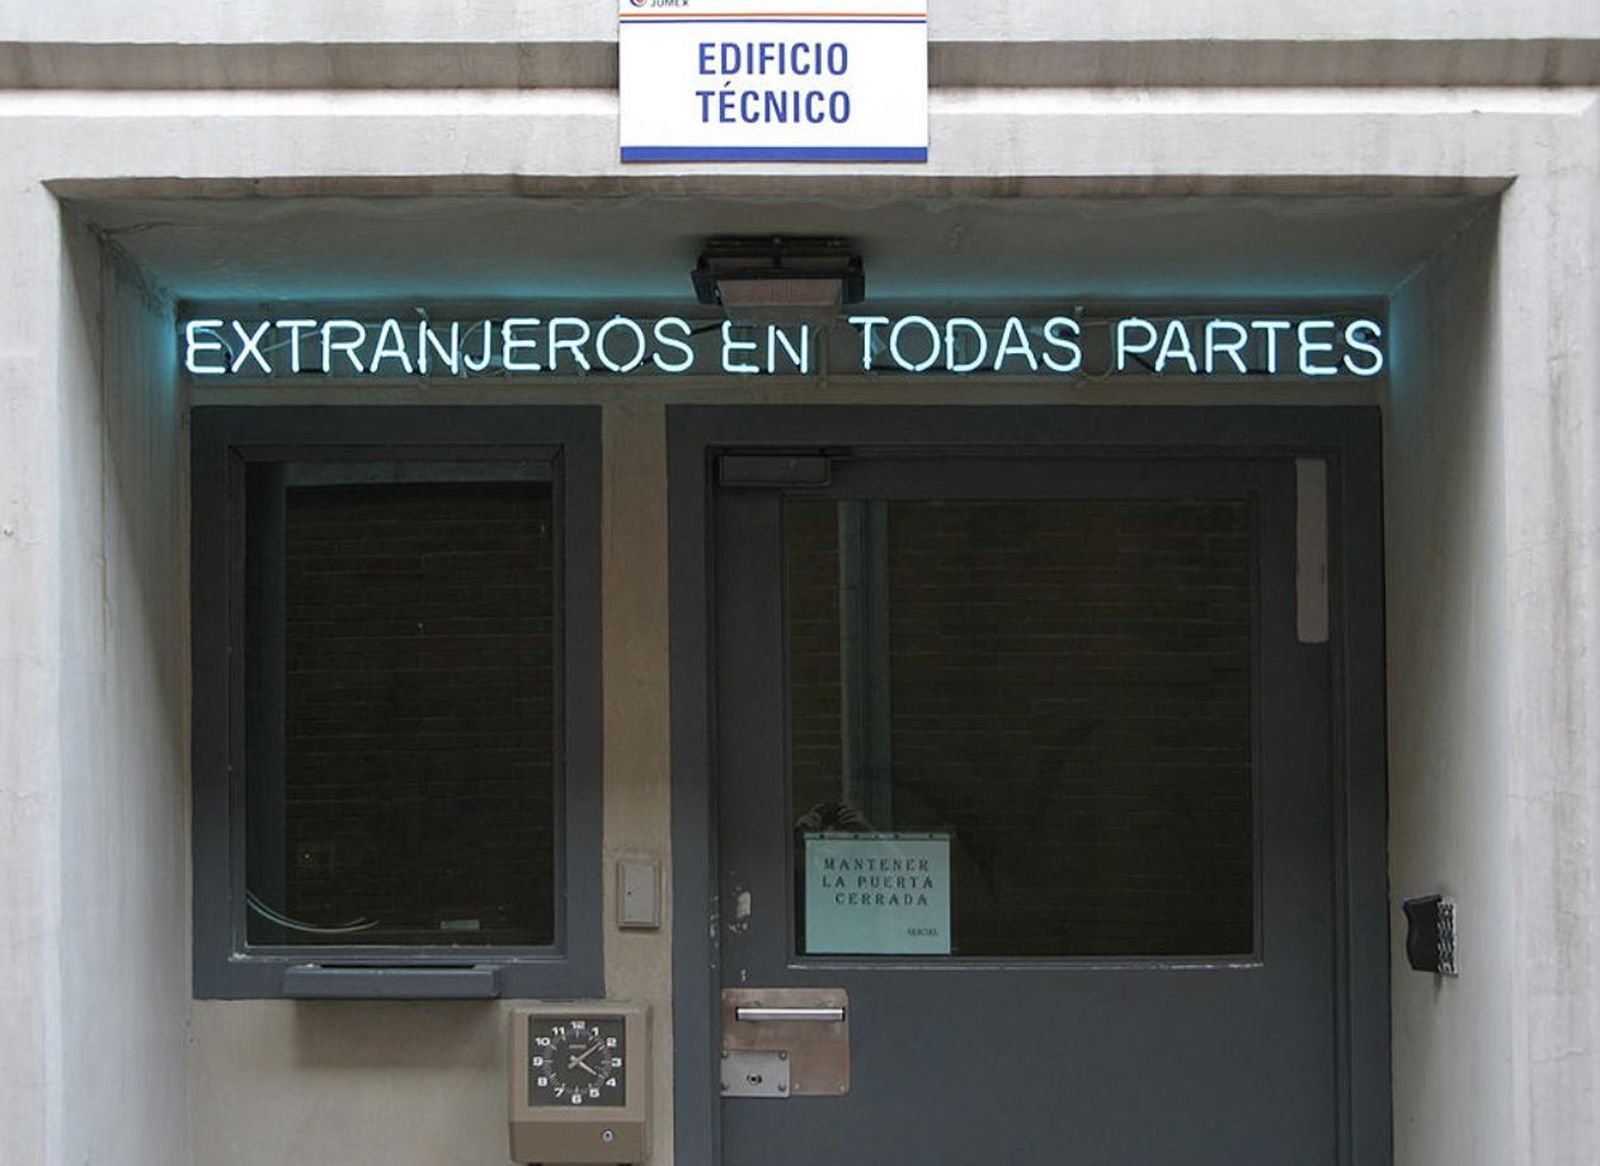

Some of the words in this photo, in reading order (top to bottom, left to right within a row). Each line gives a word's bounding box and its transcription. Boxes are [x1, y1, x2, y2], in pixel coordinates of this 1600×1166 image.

[698, 42, 848, 75] EDIFICIO
[695, 81, 851, 123] TÉCNICO
[185, 316, 695, 374] EXTRANJEROS
[720, 319, 810, 374] EN
[848, 315, 1082, 373] TODAS
[1116, 317, 1384, 376] PARTES
[824, 858, 929, 871] MANTENER
[822, 875, 846, 888] LA
[857, 875, 933, 888] PUERTA
[835, 892, 928, 906] CERRADA
[570, 1020, 586, 1029] 12
[551, 1026, 565, 1036] 11
[591, 1026, 600, 1036] 1
[535, 1037, 551, 1047] 10
[606, 1037, 617, 1047] 2
[532, 1056, 544, 1067] 9
[611, 1057, 622, 1068] 3
[537, 1076, 548, 1087] 8
[605, 1077, 617, 1087] 4
[554, 1086, 565, 1098] 7
[589, 1087, 600, 1098] 5
[571, 1093, 583, 1105] 6
